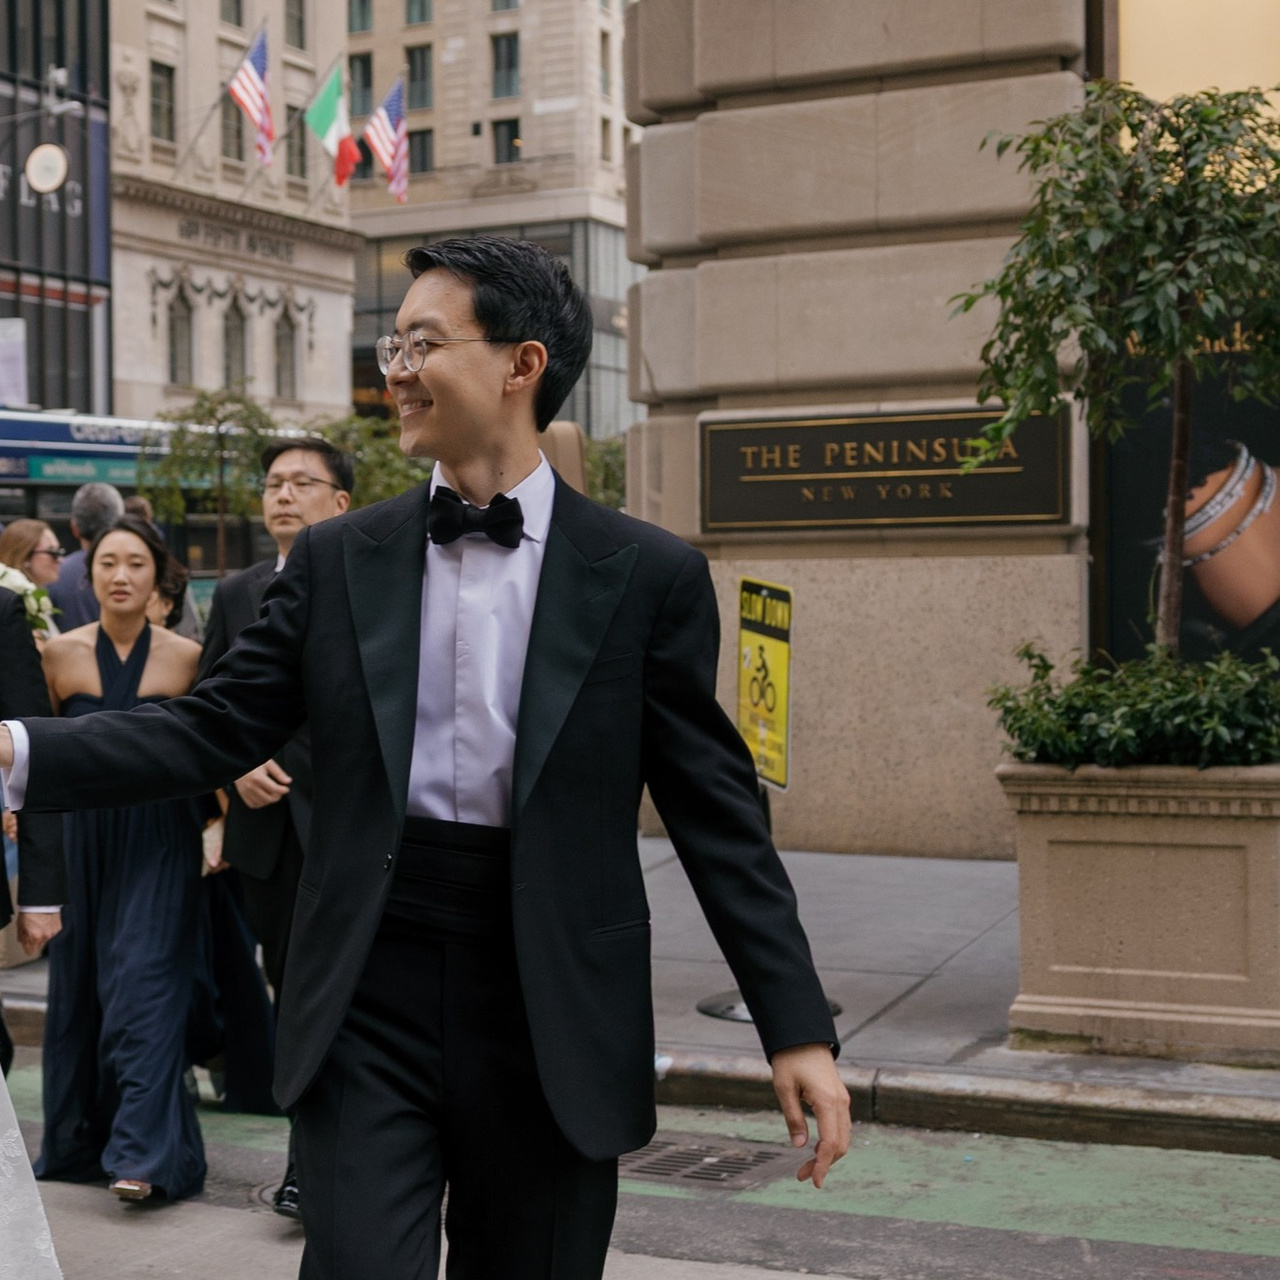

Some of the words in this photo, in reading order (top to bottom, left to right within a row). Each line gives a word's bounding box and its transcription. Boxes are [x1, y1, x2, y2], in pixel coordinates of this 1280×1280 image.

[740, 444, 802, 470] THE
[824, 436, 1019, 468] PENINSUA
[801, 483, 858, 503] NEW
[877, 481, 954, 501] YORK
[741, 590, 763, 622] SLOW
[765, 596, 790, 630] DOWN
